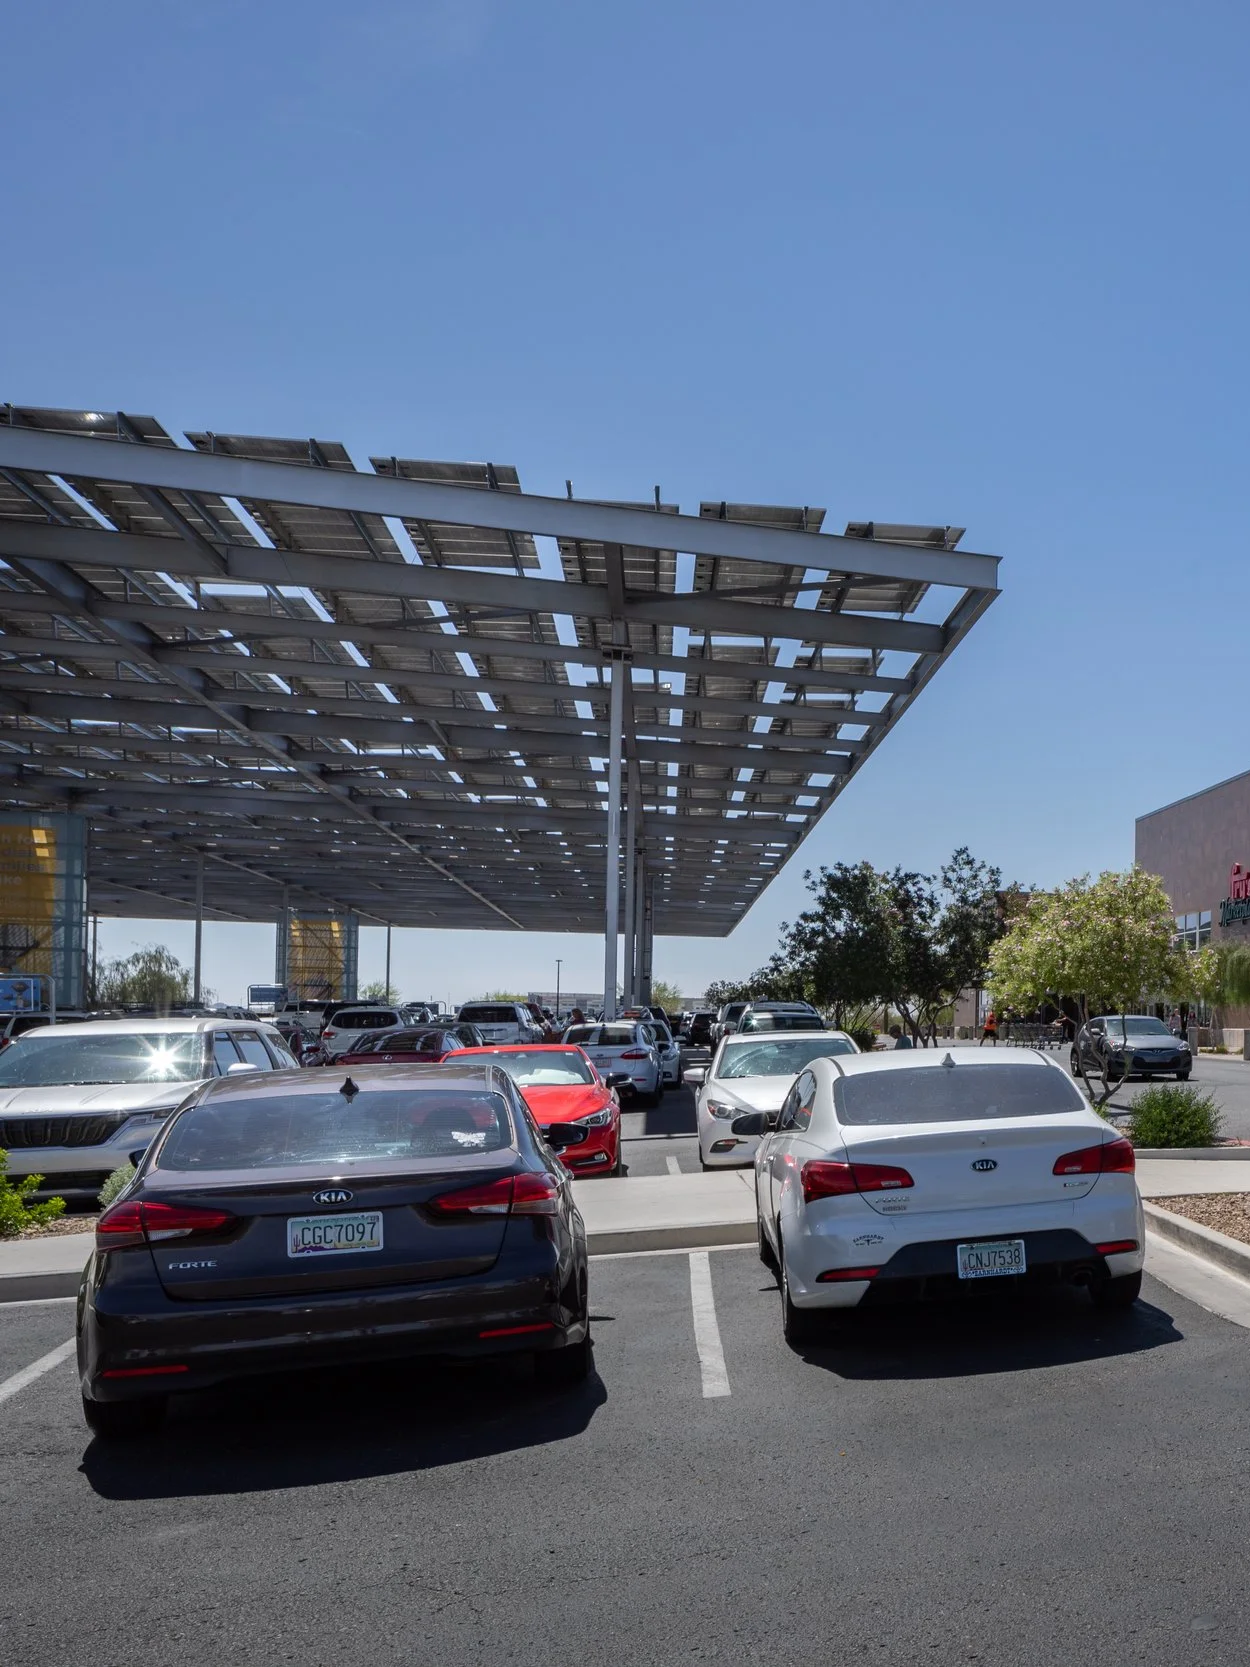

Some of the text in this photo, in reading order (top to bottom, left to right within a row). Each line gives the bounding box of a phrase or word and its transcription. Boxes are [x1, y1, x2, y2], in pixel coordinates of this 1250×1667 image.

[975, 1161, 995, 1171] KIA
[319, 1193, 347, 1203] KIA
[301, 1222, 376, 1246] CGC7097
[968, 1248, 1021, 1269] CNJ7538
[168, 1260, 218, 1270] FORTE
